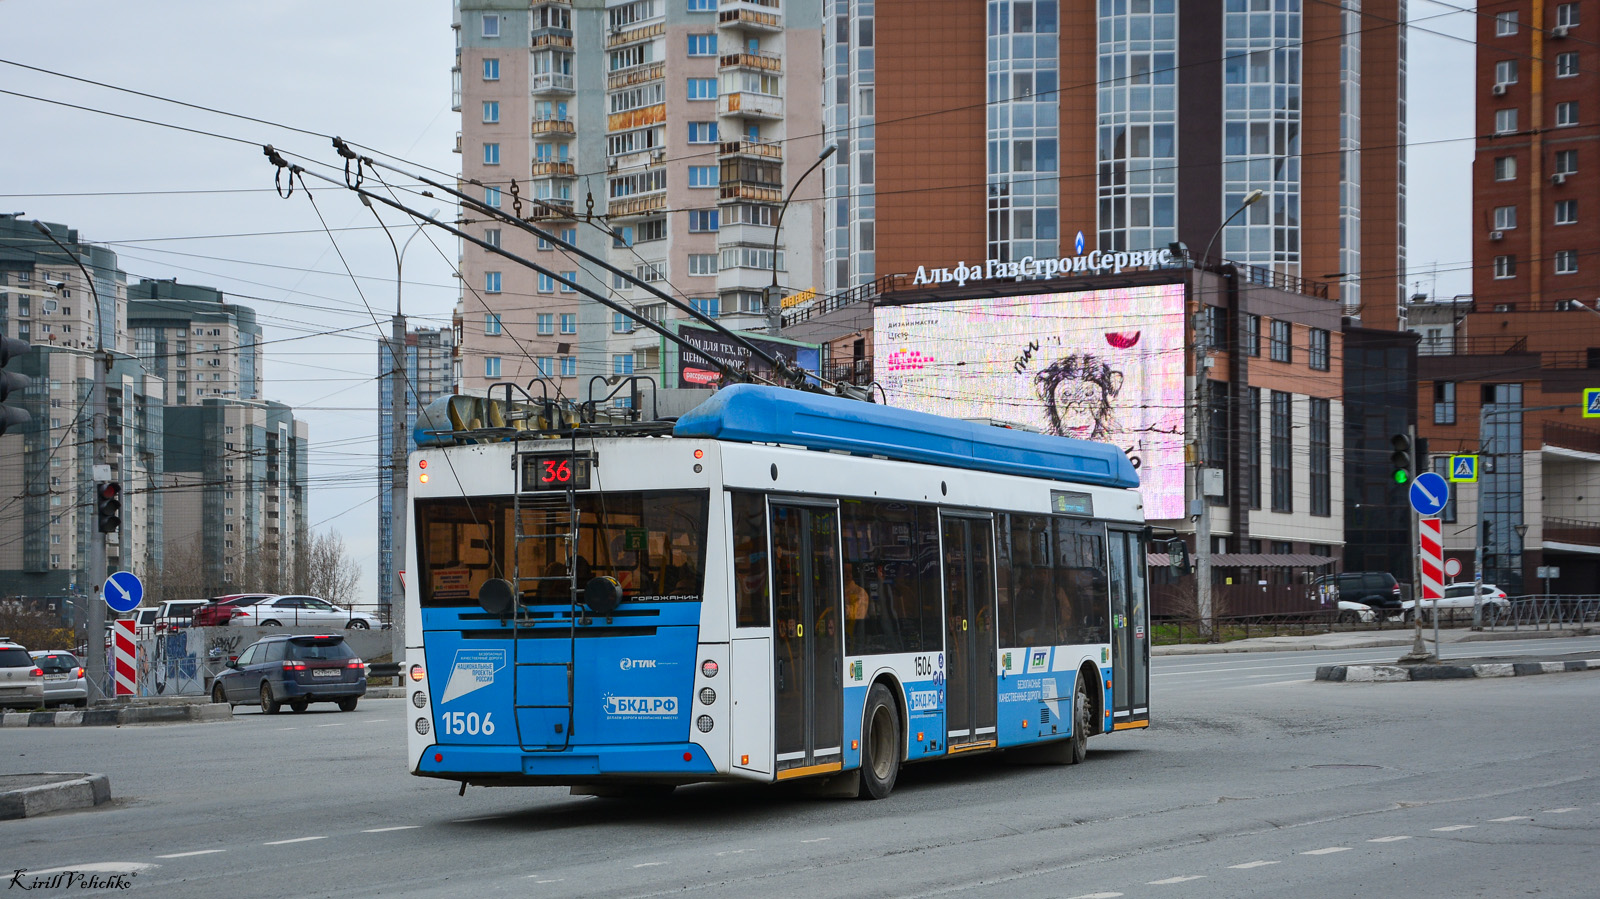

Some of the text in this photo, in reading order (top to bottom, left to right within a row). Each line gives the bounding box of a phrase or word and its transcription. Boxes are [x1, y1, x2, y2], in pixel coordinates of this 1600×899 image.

[912, 261, 982, 287] Альфа
[703, 340, 718, 352] ДЛЯ
[720, 343, 736, 356] ТЕХ,
[683, 351, 709, 364] ЦЕНИ
[686, 372, 712, 381] рассрочка
[541, 459, 571, 483] 36
[632, 659, 656, 668] ГТЛК
[914, 655, 932, 676] 1506
[618, 698, 676, 713] БКД.РФ
[915, 693, 937, 708] БКД.РФ
[442, 711, 495, 736] 1506
